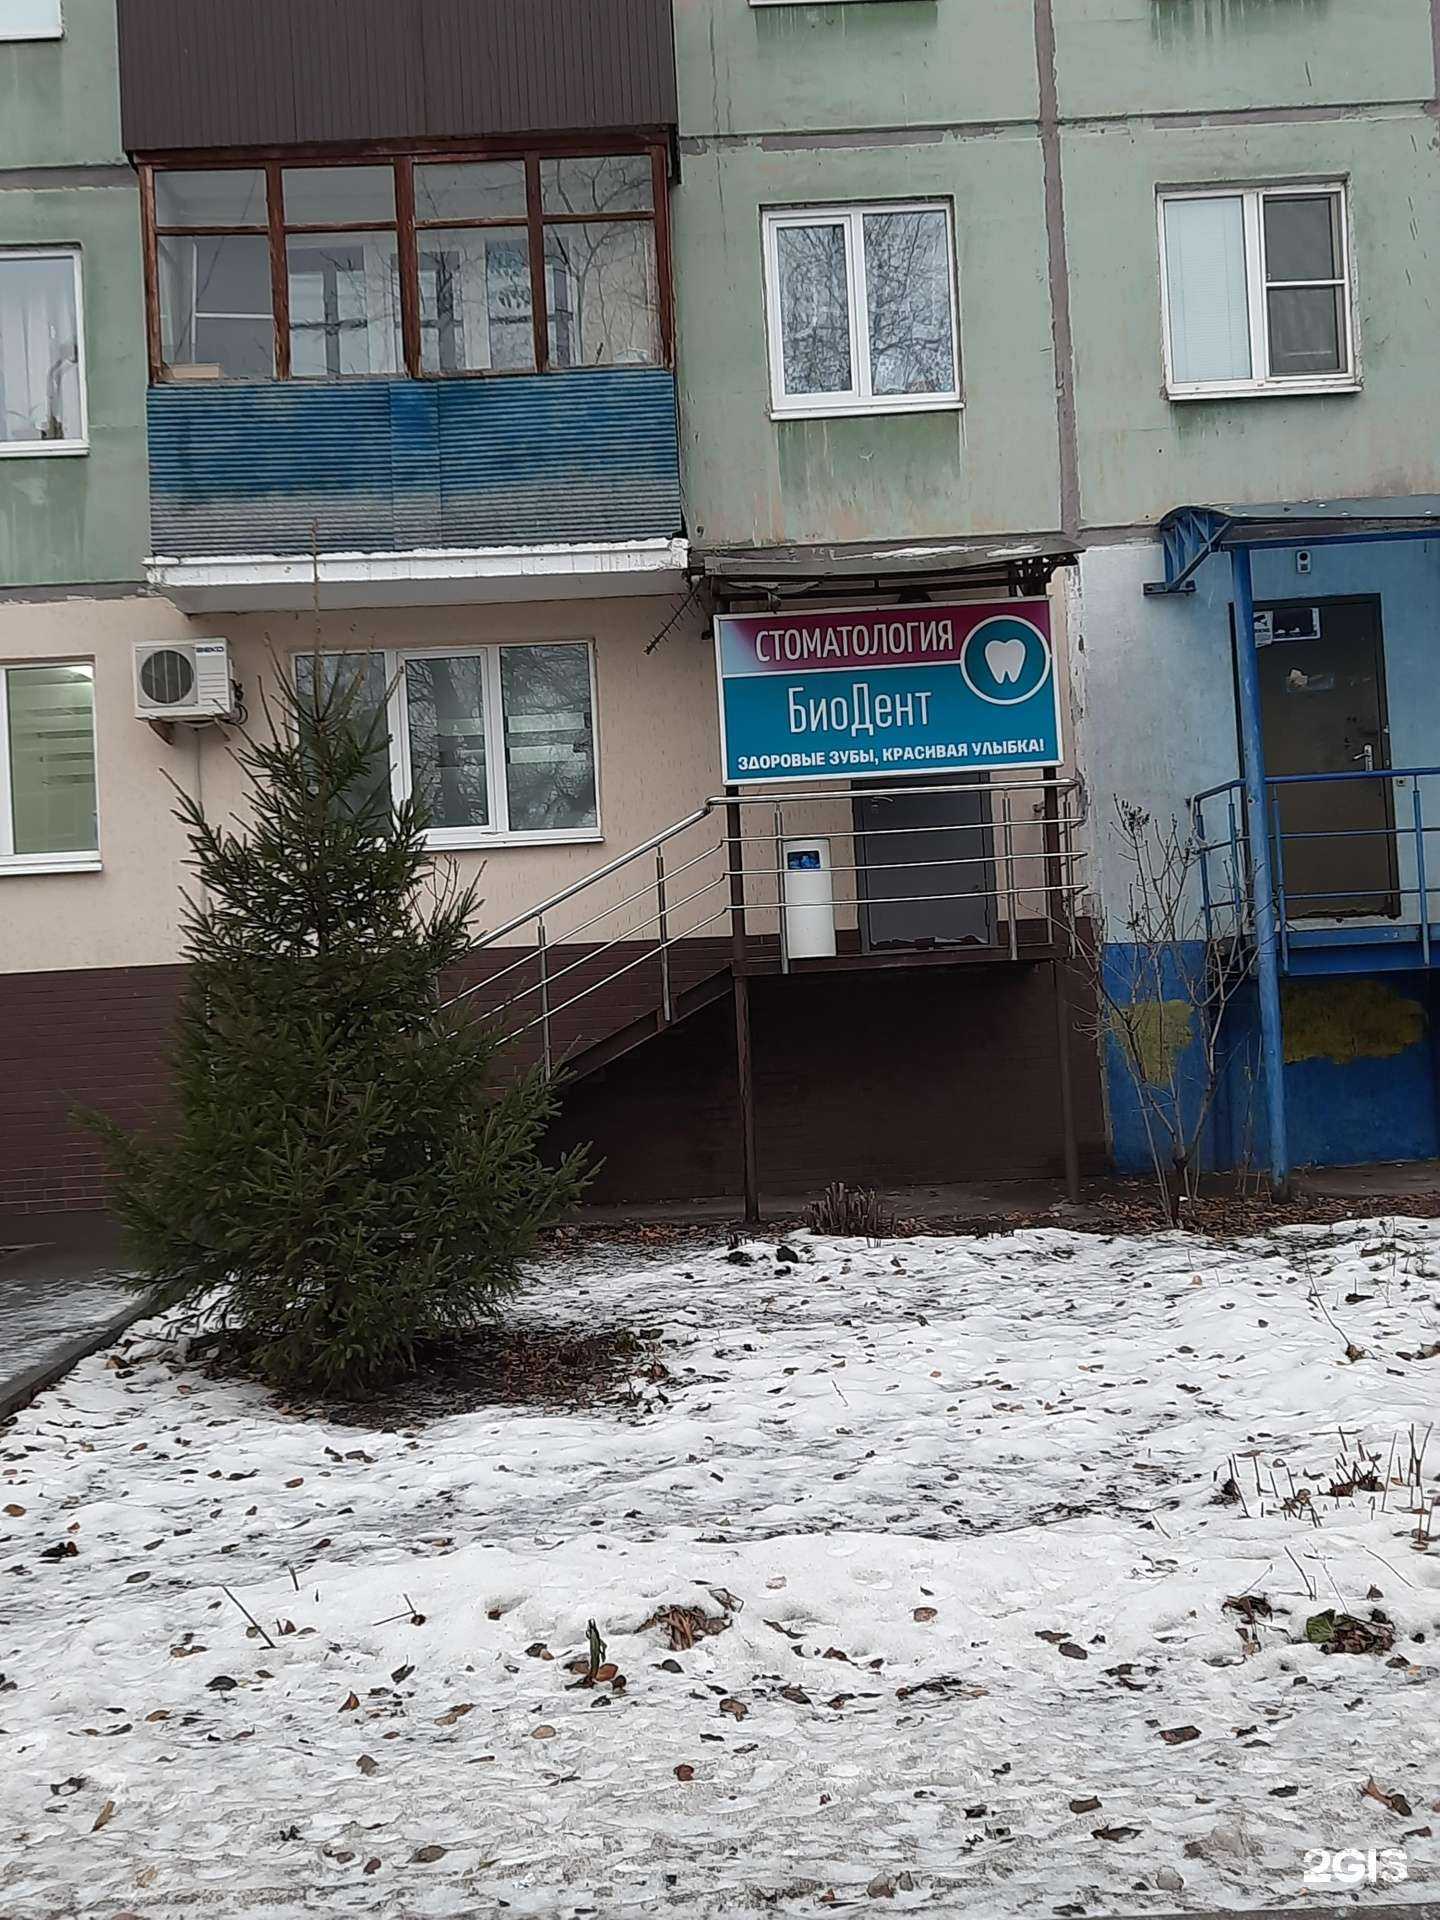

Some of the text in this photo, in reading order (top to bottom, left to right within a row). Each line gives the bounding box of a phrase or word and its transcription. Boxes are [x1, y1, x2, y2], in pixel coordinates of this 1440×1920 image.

[755, 619, 953, 662] СТОМАТОЛОГИЯ
[787, 683, 932, 737] БиоДент
[738, 738, 1045, 770] ЗДОРОВЫЕ ЗУБЫ, КРАСИВАЯ УЛЫБКА!
